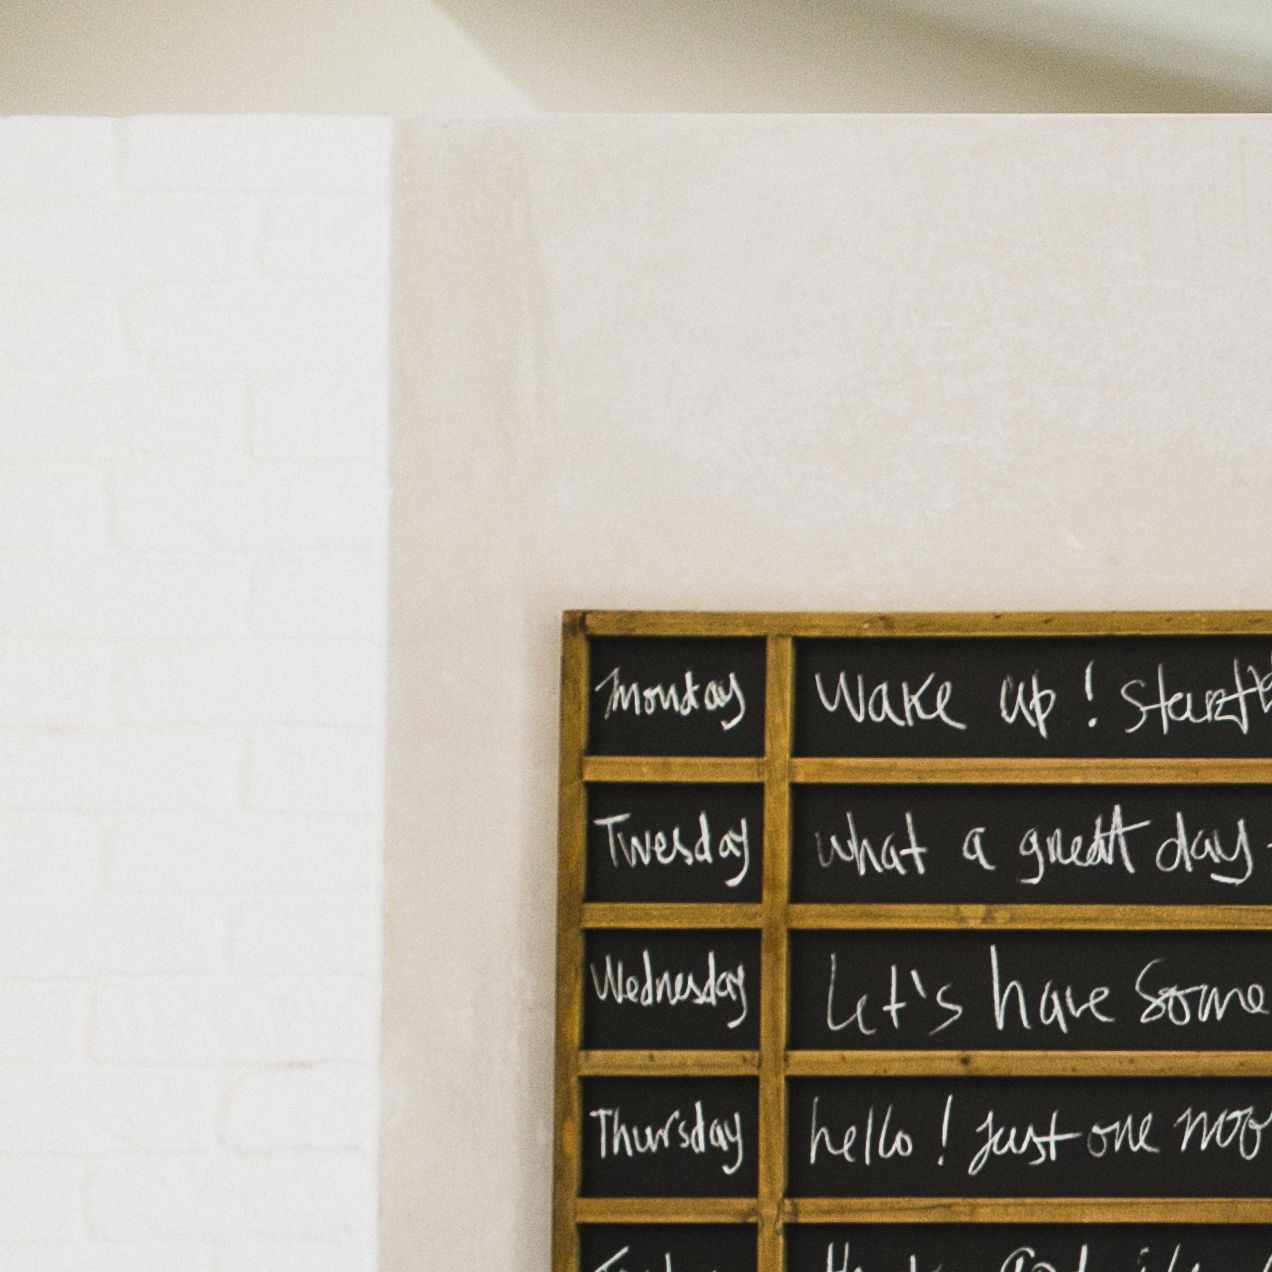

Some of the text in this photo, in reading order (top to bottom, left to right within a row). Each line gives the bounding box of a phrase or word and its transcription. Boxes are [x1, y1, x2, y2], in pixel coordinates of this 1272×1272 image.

[594, 667, 746, 731] Monday
[814, 671, 967, 730] Wake
[593, 811, 750, 888] Tuesday
[962, 826, 996, 871] a
[1019, 804, 1151, 885] great
[1155, 811, 1254, 886] day
[592, 949, 747, 1029] Wednesday
[989, 944, 1115, 1034] have
[589, 1100, 743, 1175] Thursday
[1089, 1112, 1160, 1158] one
